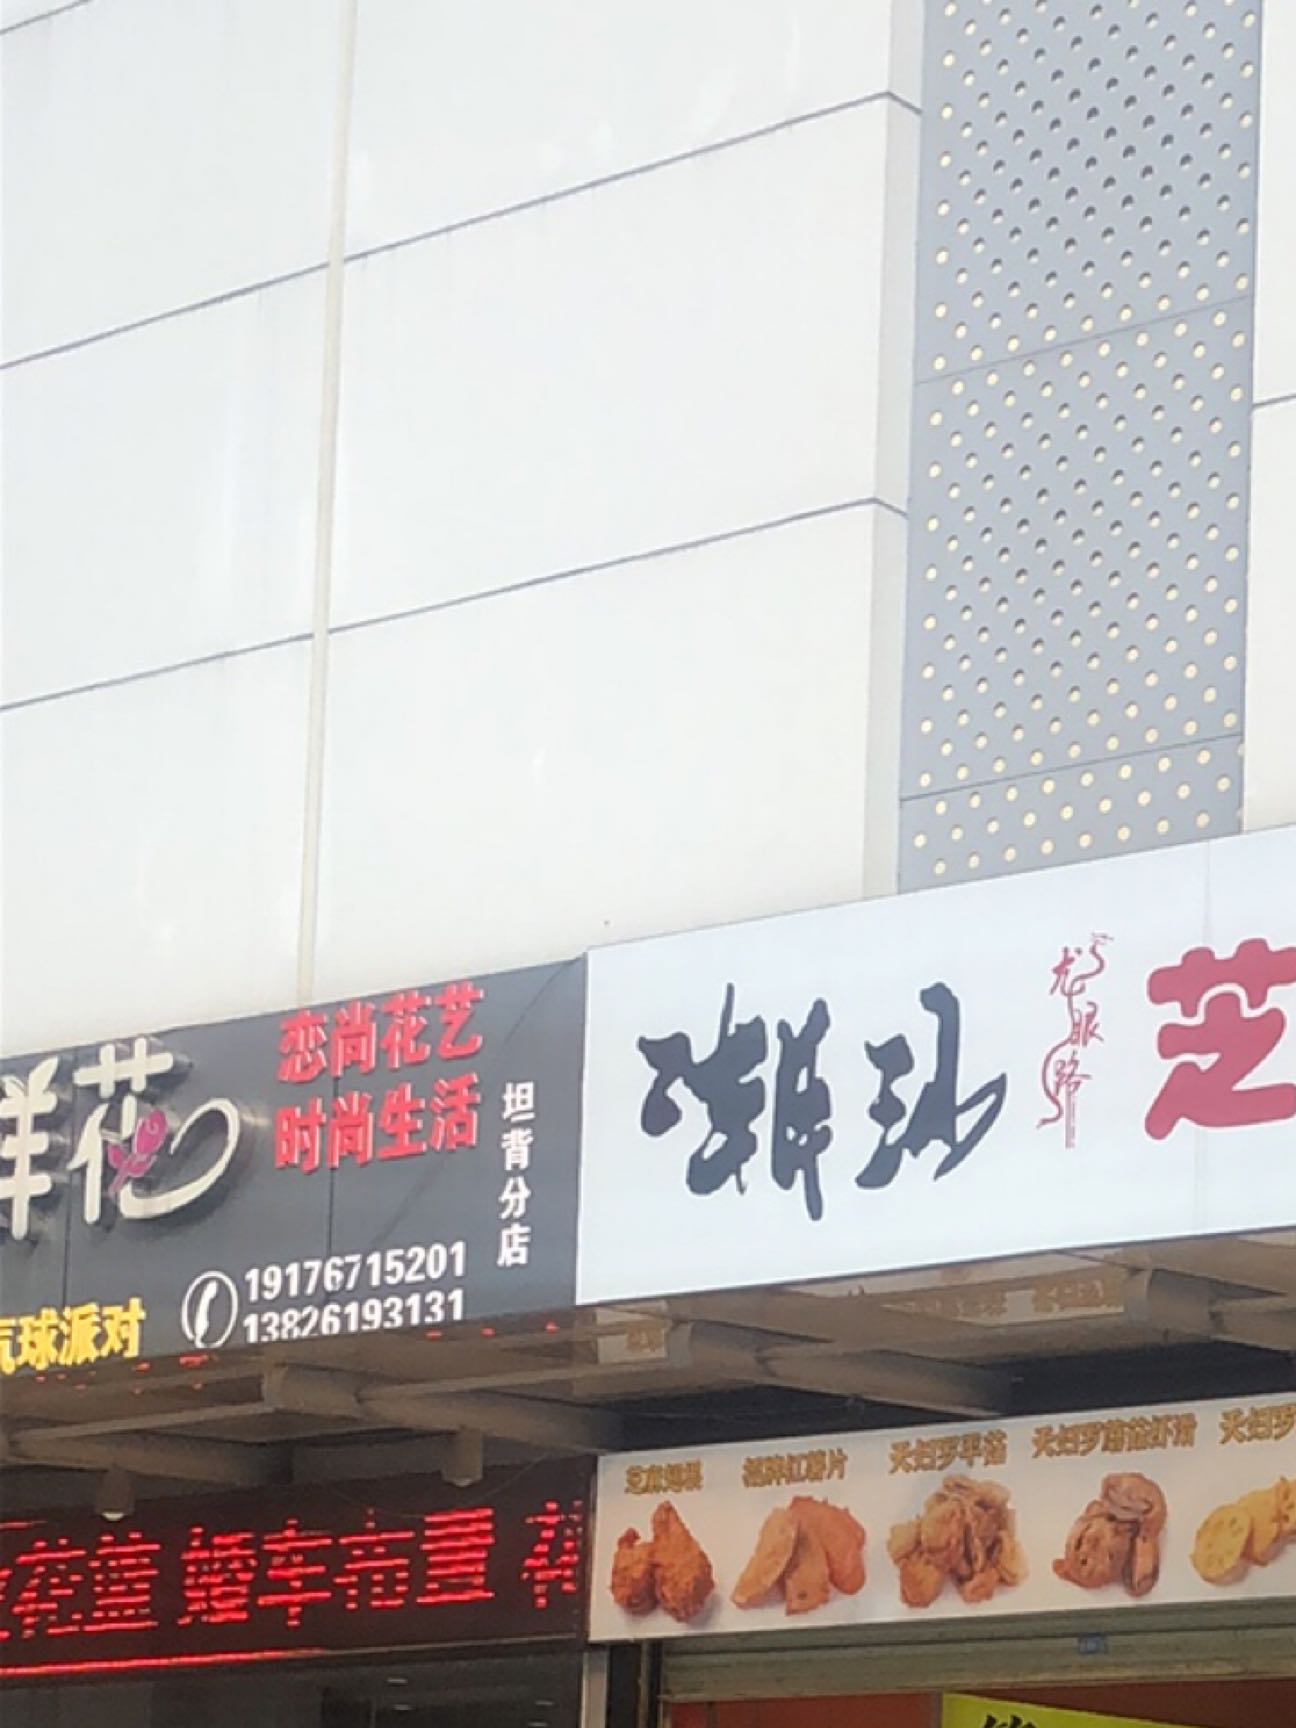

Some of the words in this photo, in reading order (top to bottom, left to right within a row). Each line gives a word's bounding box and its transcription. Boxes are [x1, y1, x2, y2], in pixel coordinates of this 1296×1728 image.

[277, 980, 484, 1083] 恋尚花艺
[273, 1072, 481, 1174] 时尚生活
[496, 1080, 536, 1268] 坦背分店
[243, 1290, 466, 1344] 13826193131
[244, 1241, 467, 1303] 19176715201
[0, 1530, 162, 1641] 花篮
[177, 1505, 497, 1628] 婚车布置
